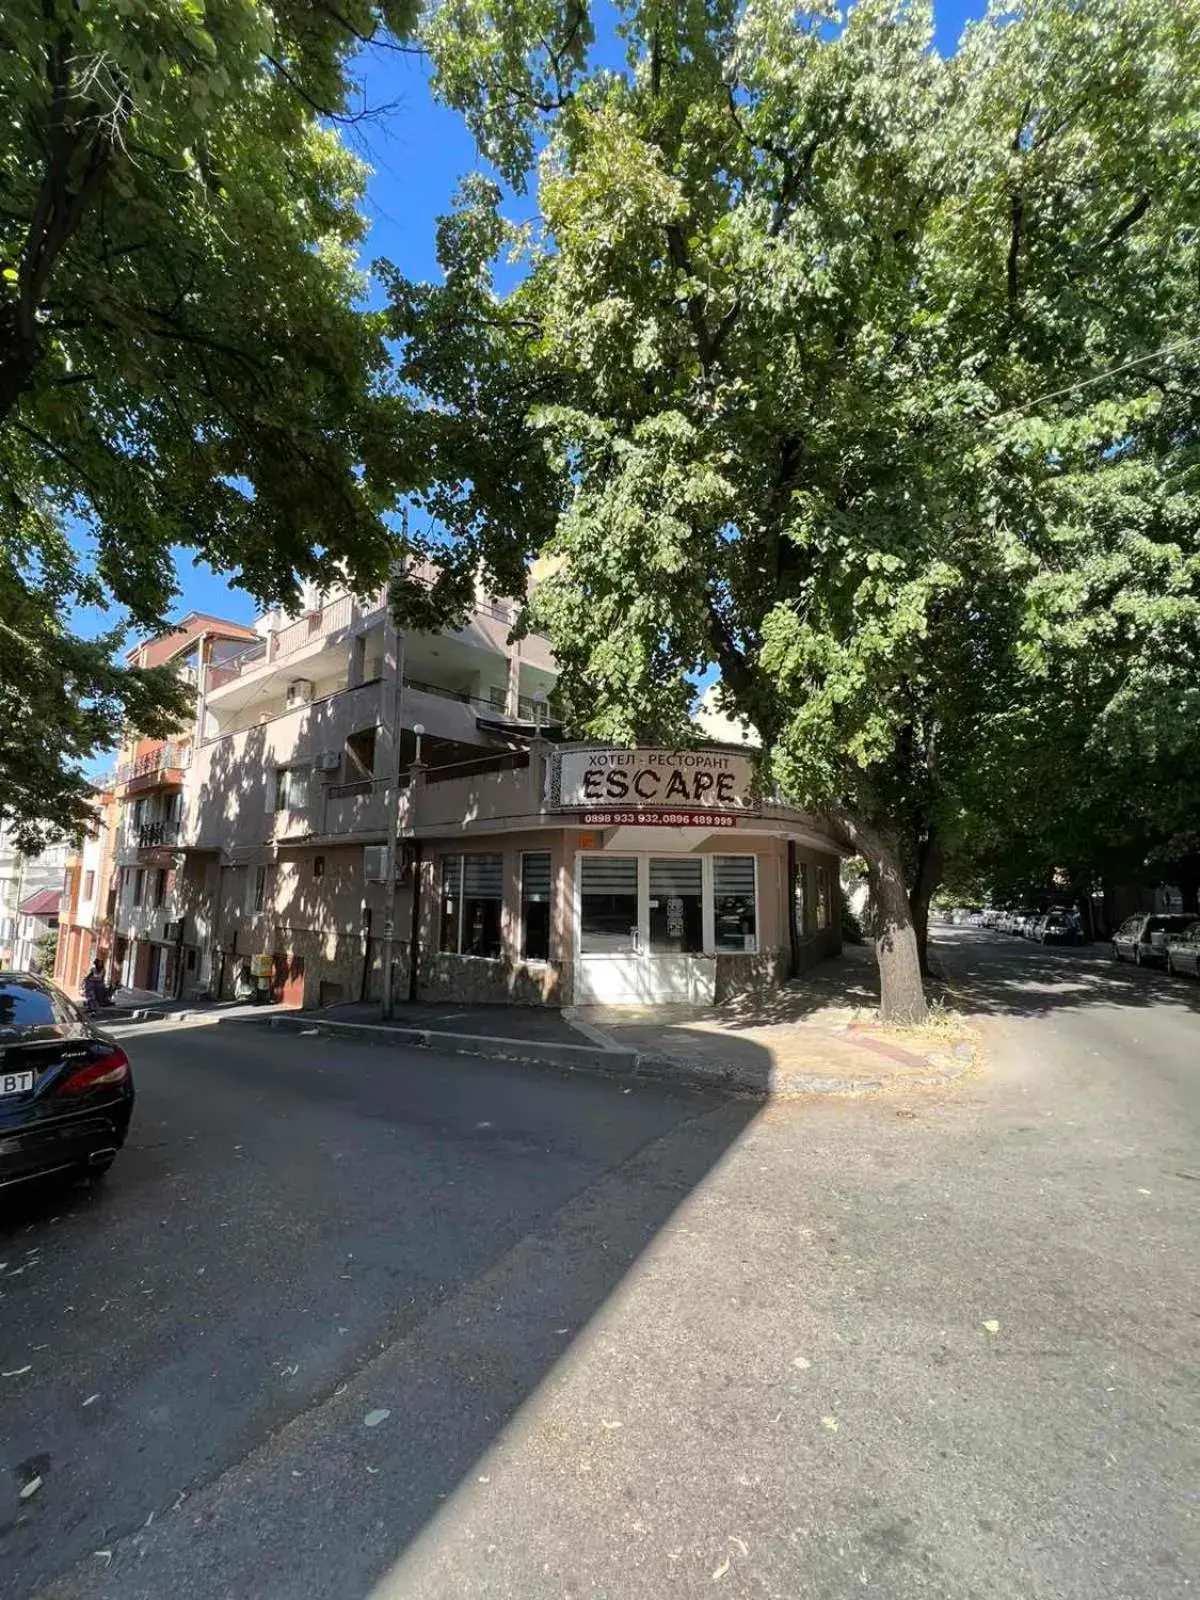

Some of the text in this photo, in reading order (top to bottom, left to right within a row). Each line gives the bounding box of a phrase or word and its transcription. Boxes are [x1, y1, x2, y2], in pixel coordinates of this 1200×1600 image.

[589, 755, 636, 767] ХОТЕЛ
[648, 755, 729, 769] РЕСТОРАНТ
[584, 769, 736, 802] ESCAPE
[585, 814, 612, 824] 0898
[614, 814, 635, 823] 933
[5, 1074, 29, 1092] BT
